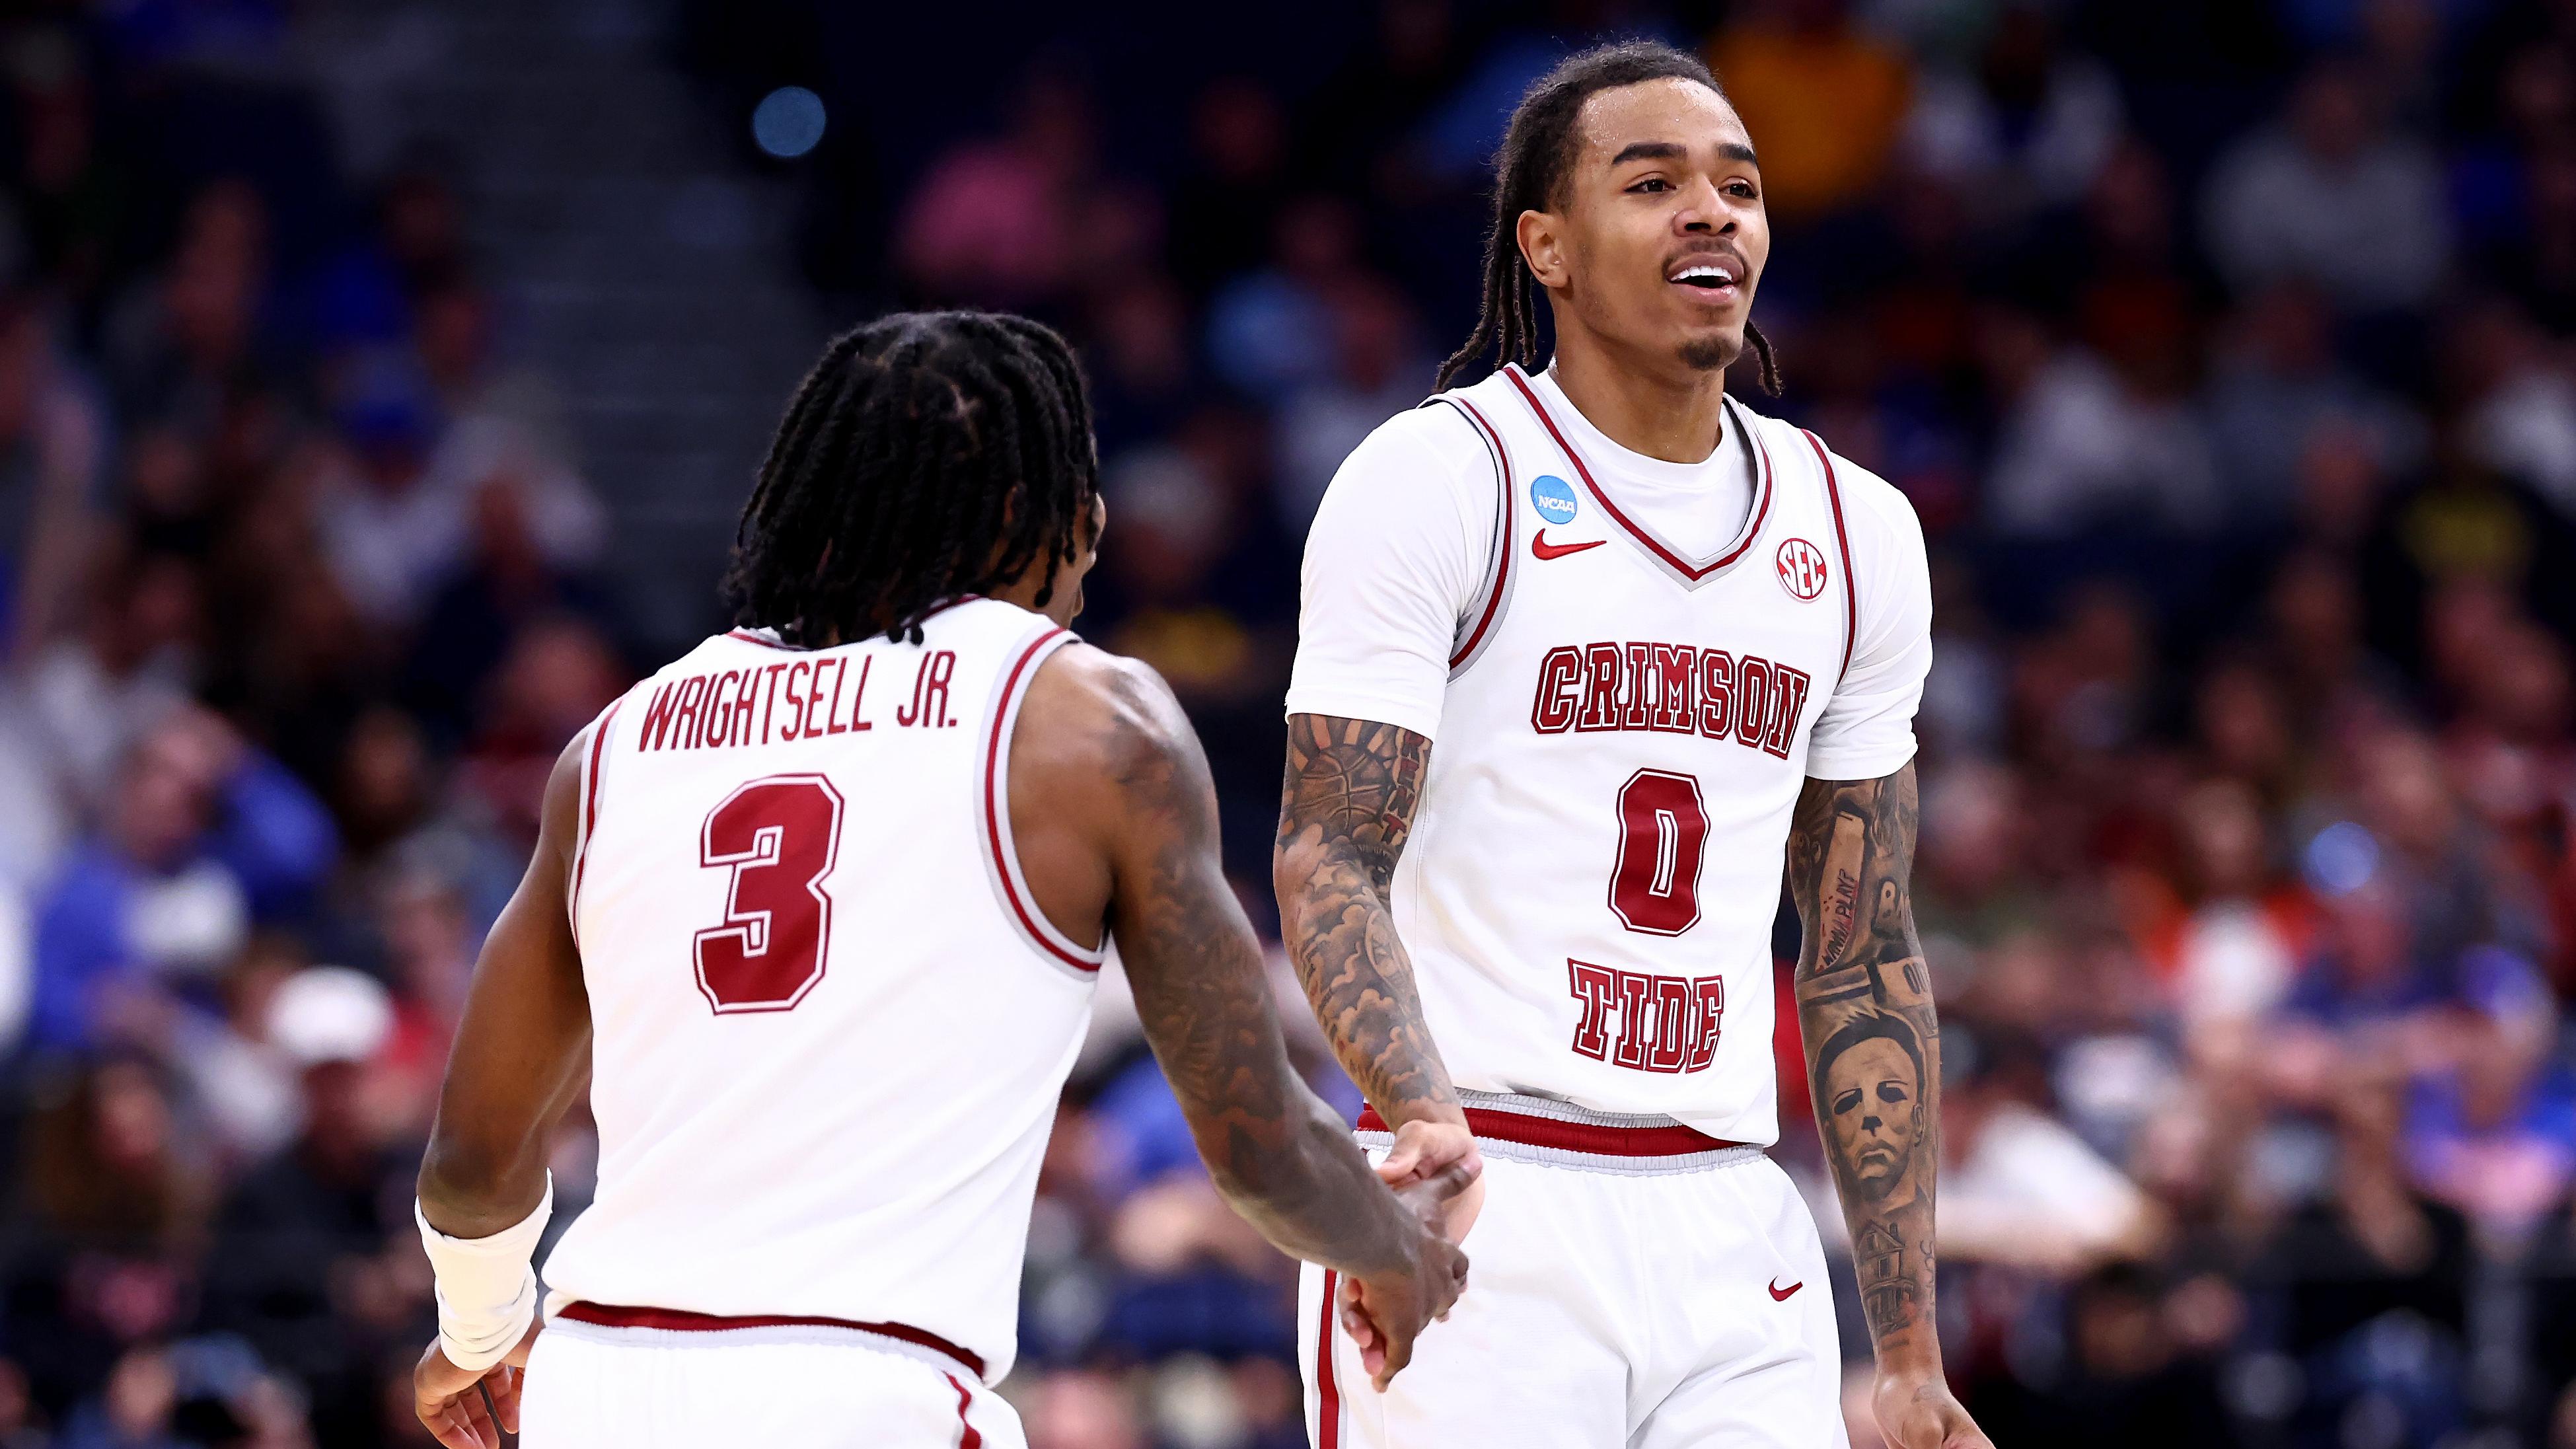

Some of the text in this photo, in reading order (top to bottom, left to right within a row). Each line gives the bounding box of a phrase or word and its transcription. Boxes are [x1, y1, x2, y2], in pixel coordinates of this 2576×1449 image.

[1537, 494, 1576, 515] NCAA
[1777, 540, 1825, 597] SEC
[638, 650, 958, 752] WRIGHTSELL JR.
[1531, 641, 1811, 761] CRIMSON
[692, 772, 845, 1016] 3
[1607, 767, 1711, 938] 0
[1566, 957, 1724, 1074] TIDE
